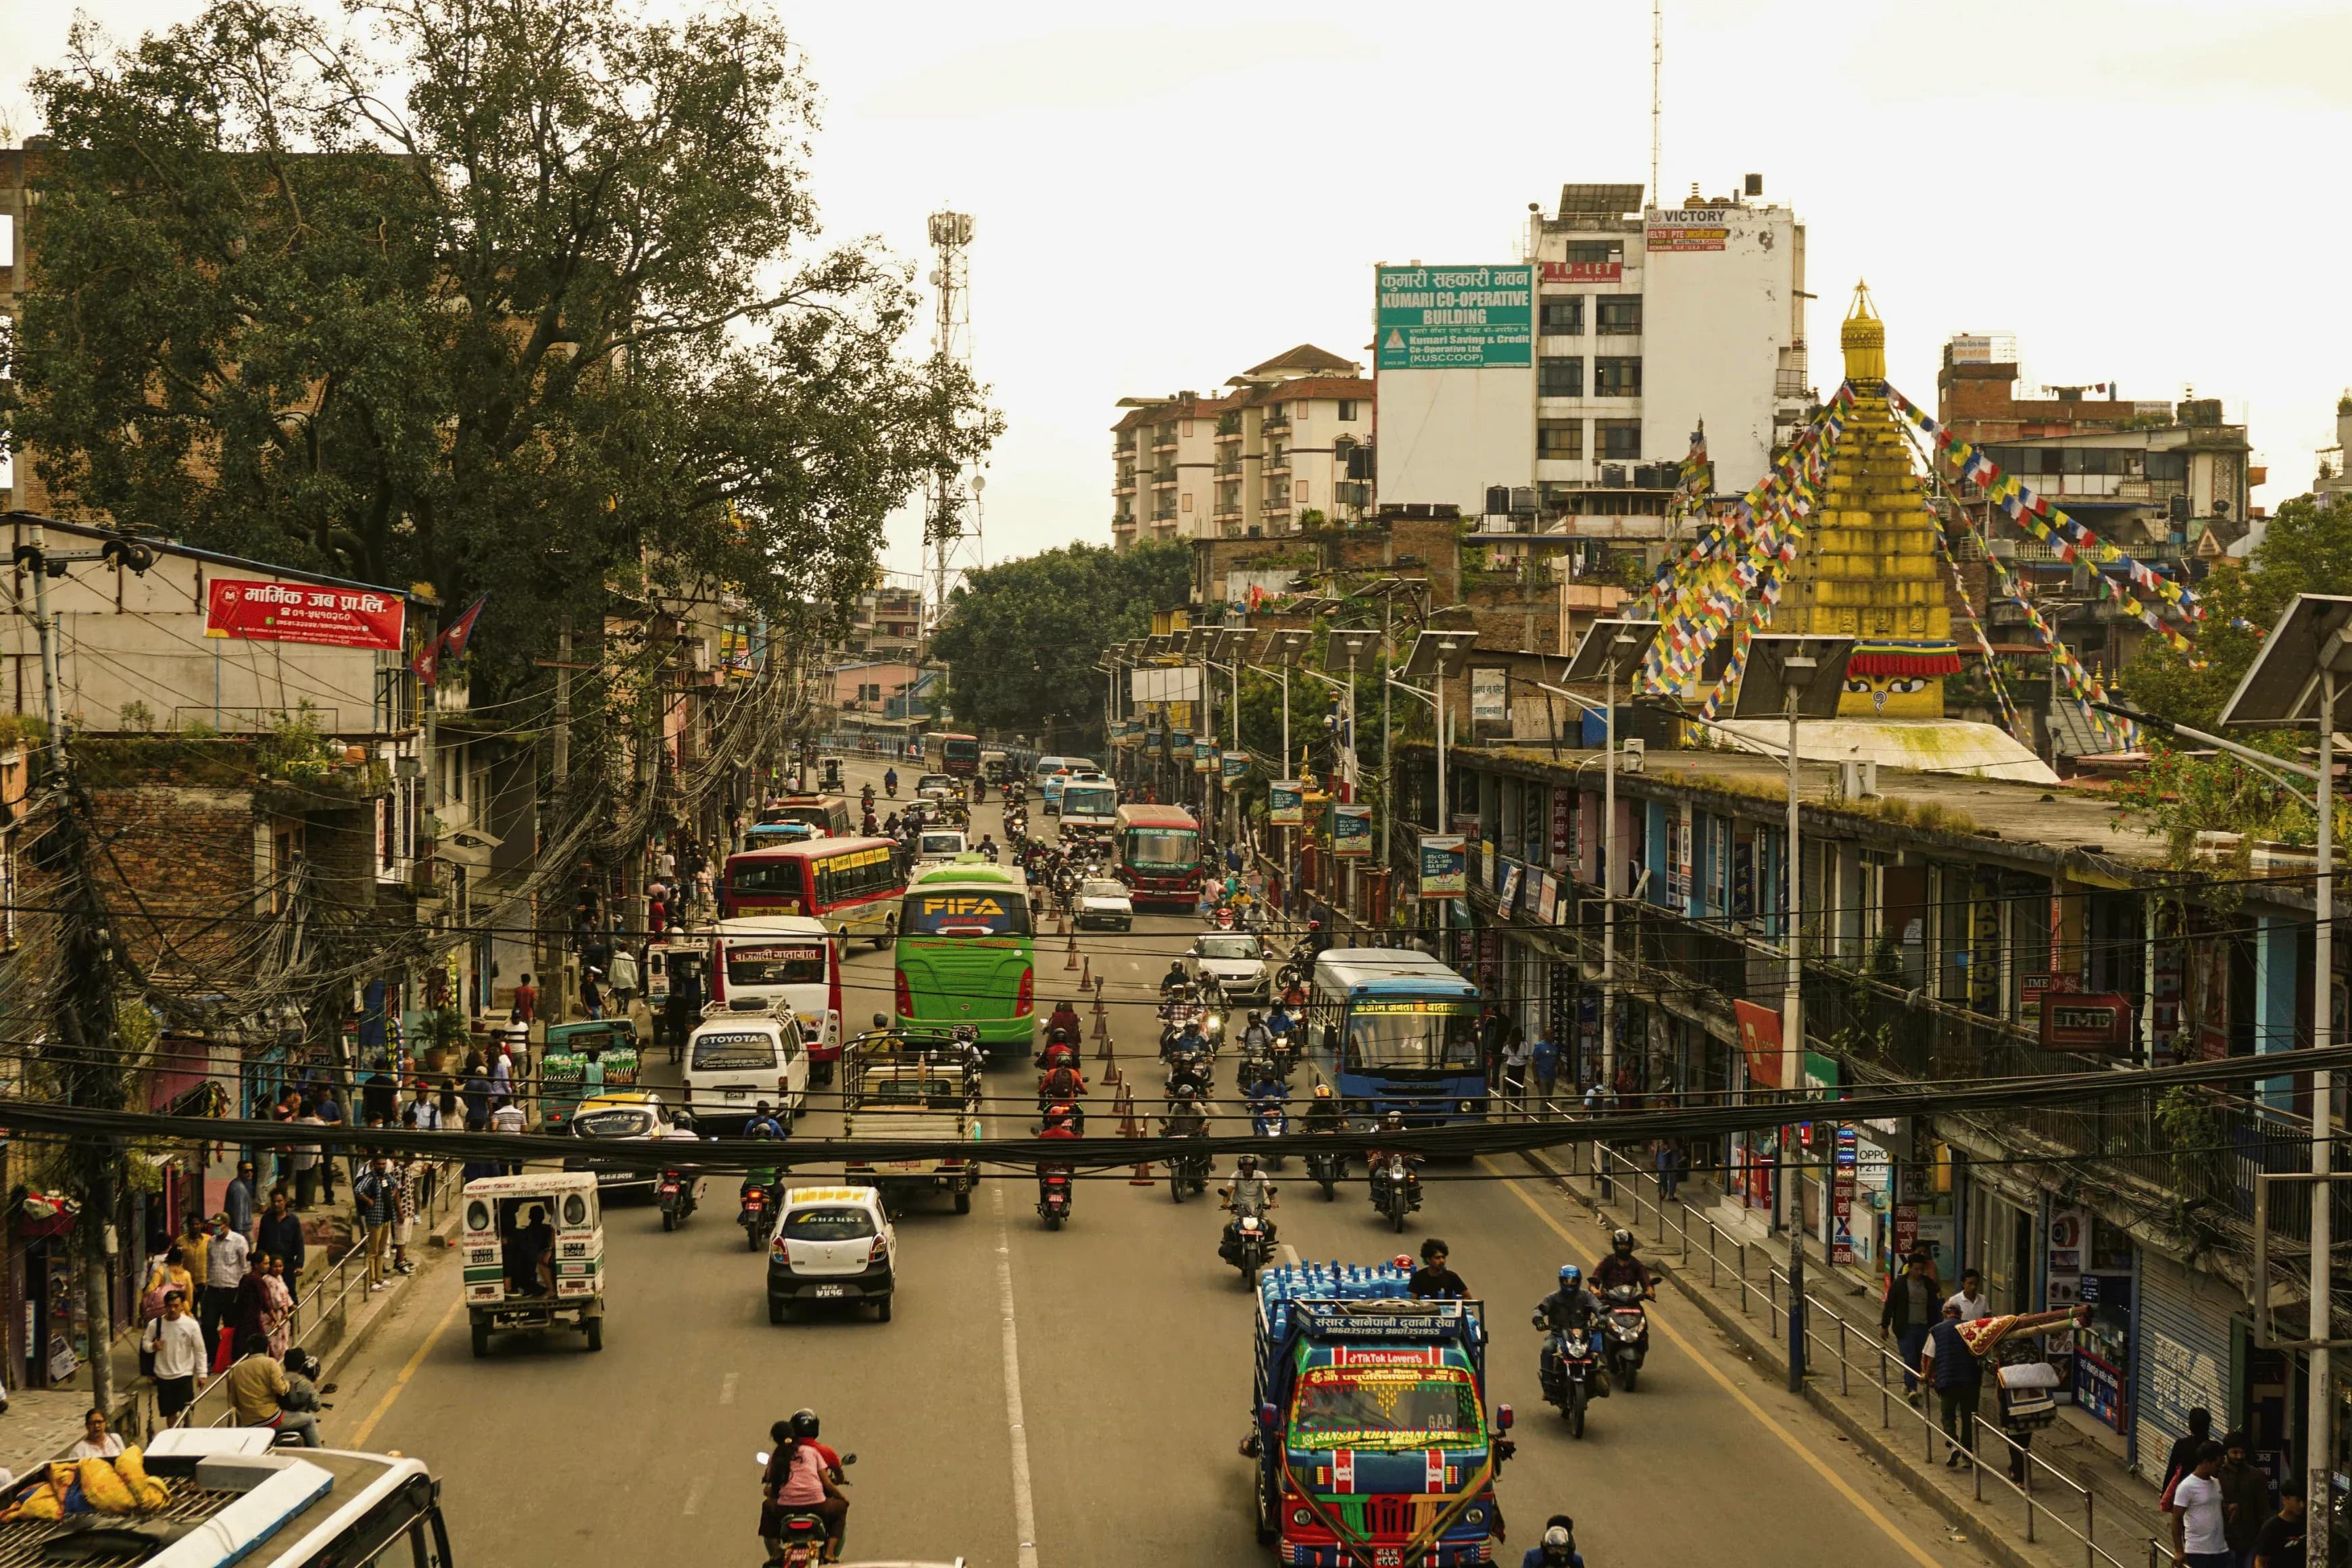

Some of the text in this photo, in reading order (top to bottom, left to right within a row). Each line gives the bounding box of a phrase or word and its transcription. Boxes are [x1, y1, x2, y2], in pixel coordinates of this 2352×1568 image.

[1665, 210, 1725, 222] VICTORY
[1648, 230, 1685, 239] IELTS PTE
[1381, 268, 1529, 292] कुमारी सहकारी भवन
[1381, 291, 1529, 308] KUMARI CO-OPERATIVE
[1423, 309, 1487, 325] BUILDING
[1409, 335, 1448, 345] Kumari
[1450, 335, 1486, 345] Saving
[1496, 335, 1530, 343] Credit
[1409, 345, 1467, 353] Co-Operative
[1410, 353, 1484, 362] (KUSCCOOP)
[245, 585, 303, 605] मार्मिक
[308, 592, 336, 608] जब
[924, 898, 1005, 915] FIFA
[2063, 1012, 2110, 1027] IME
[710, 1035, 759, 1044] TOYOTA
[1859, 1150, 1889, 1160] OPPO
[1315, 1317, 1346, 1327] संसार
[1348, 1317, 1397, 1327] खानेपानी
[1435, 1317, 1456, 1327] सेवा
[1356, 1353, 1415, 1363] TikTok Lovers
[1428, 1414, 1453, 1429] GAP
[1315, 1431, 1361, 1442] SANSAR
